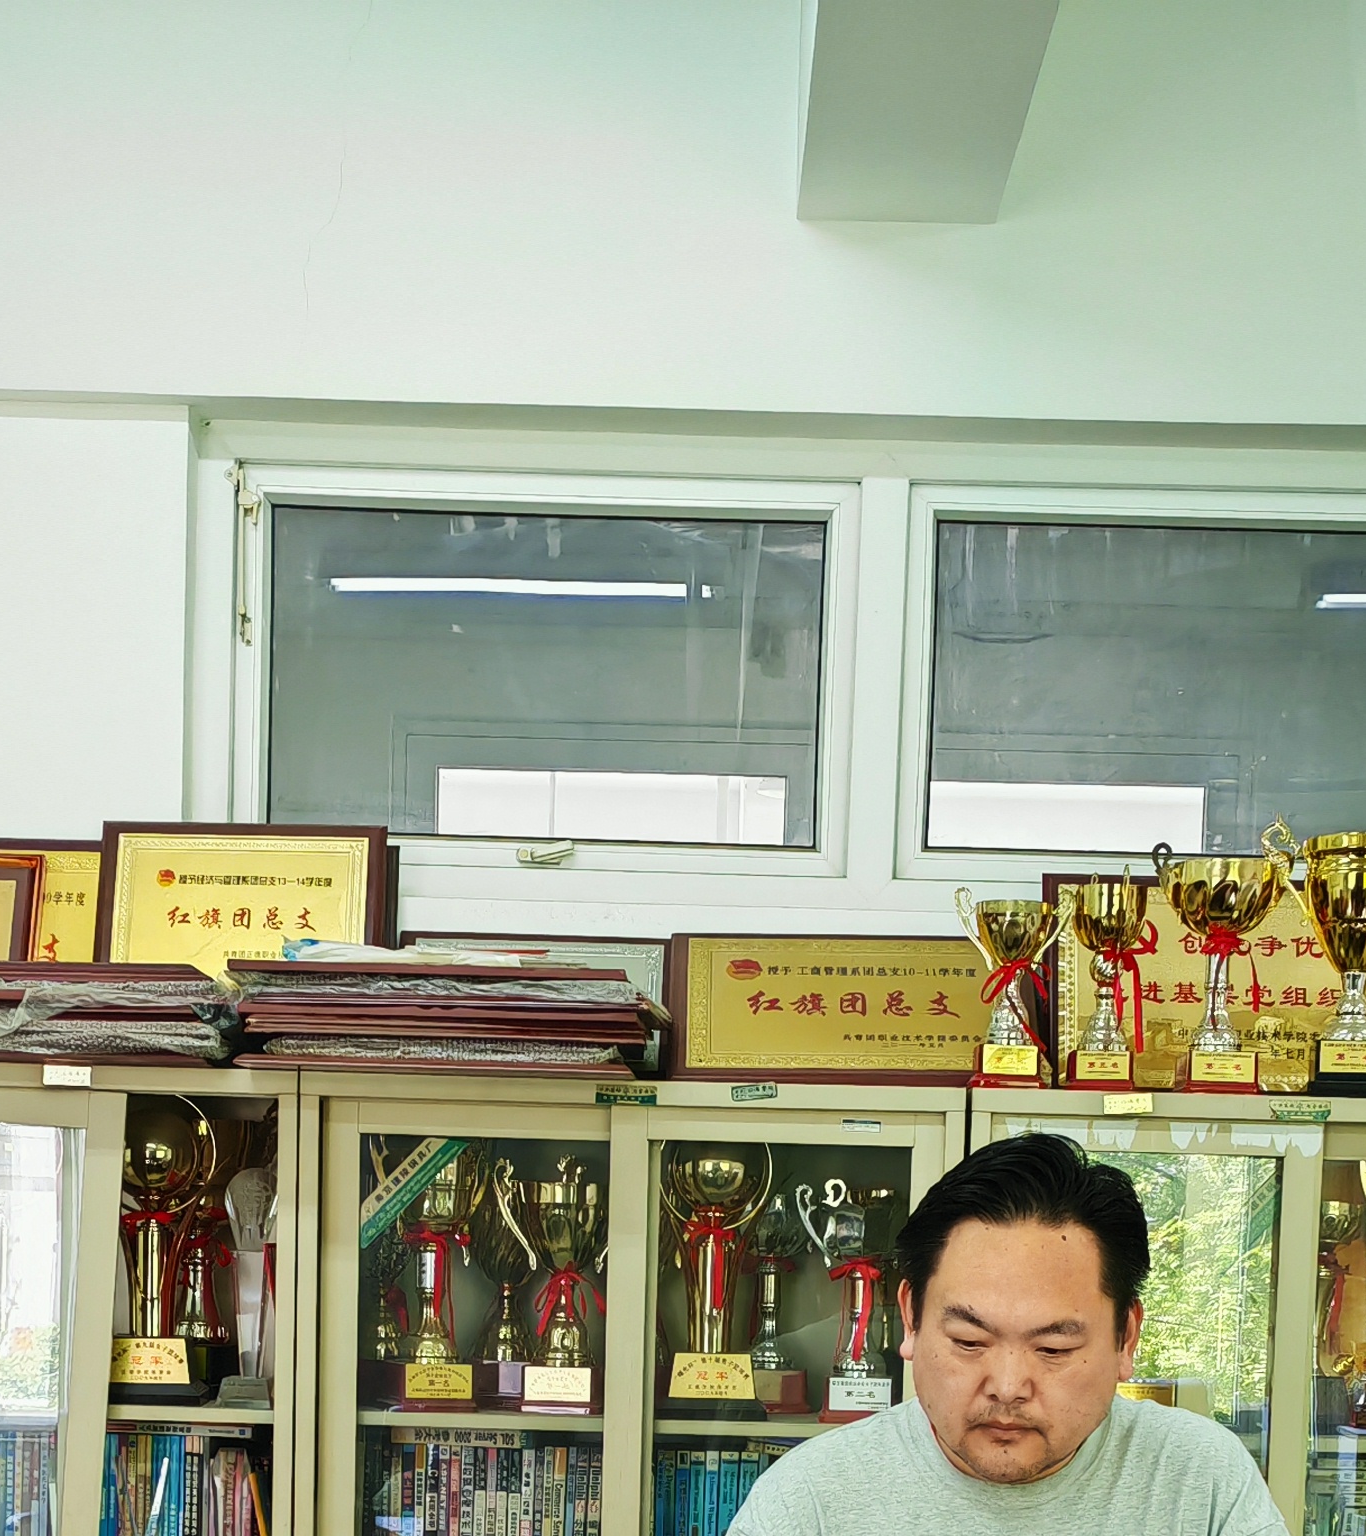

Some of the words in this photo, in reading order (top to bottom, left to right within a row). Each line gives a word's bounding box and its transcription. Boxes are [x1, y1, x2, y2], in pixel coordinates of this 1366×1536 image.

[166, 905, 318, 932] 红旗团总支
[746, 989, 962, 1019] 红旗团总支
[1119, 980, 1343, 1008] 进基党组织
